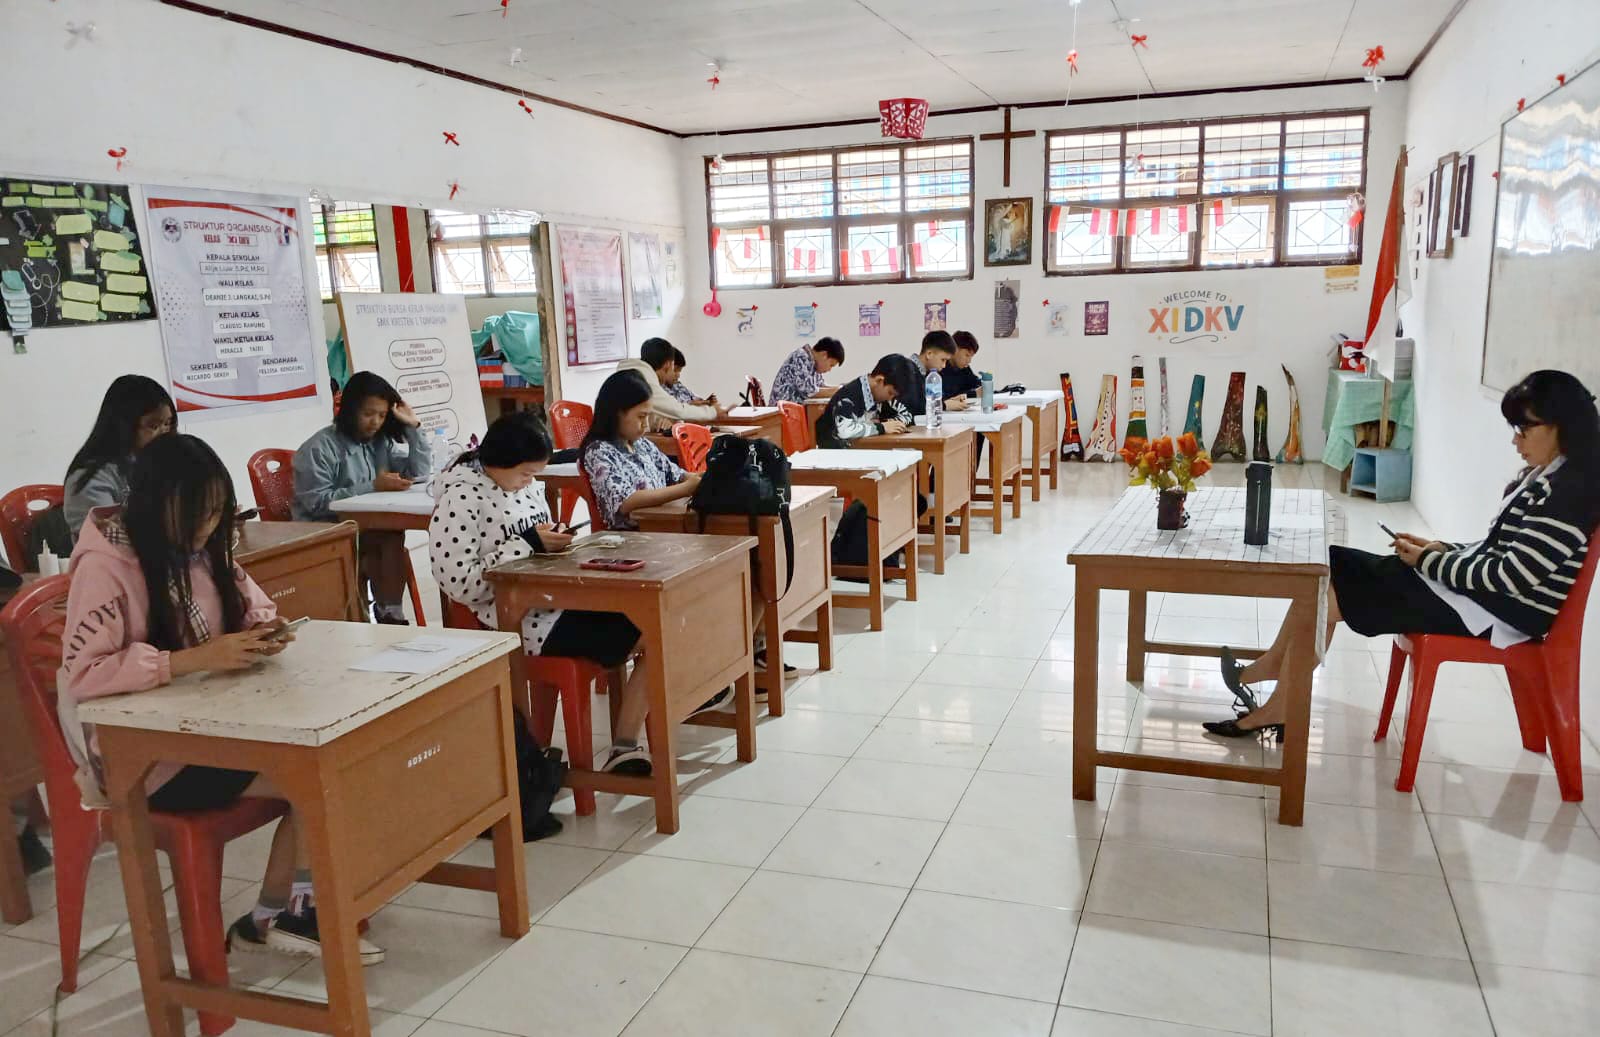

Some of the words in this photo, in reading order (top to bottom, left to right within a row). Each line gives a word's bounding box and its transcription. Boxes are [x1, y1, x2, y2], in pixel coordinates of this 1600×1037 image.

[183, 221, 226, 231] STRUKTUR
[226, 222, 272, 233] ORGANISASI
[1164, 290, 1212, 303] WELCOME
[1215, 292, 1227, 302] TO
[262, 356, 298, 365] BENDAHARA
[190, 362, 228, 371] SEKRETARIS
